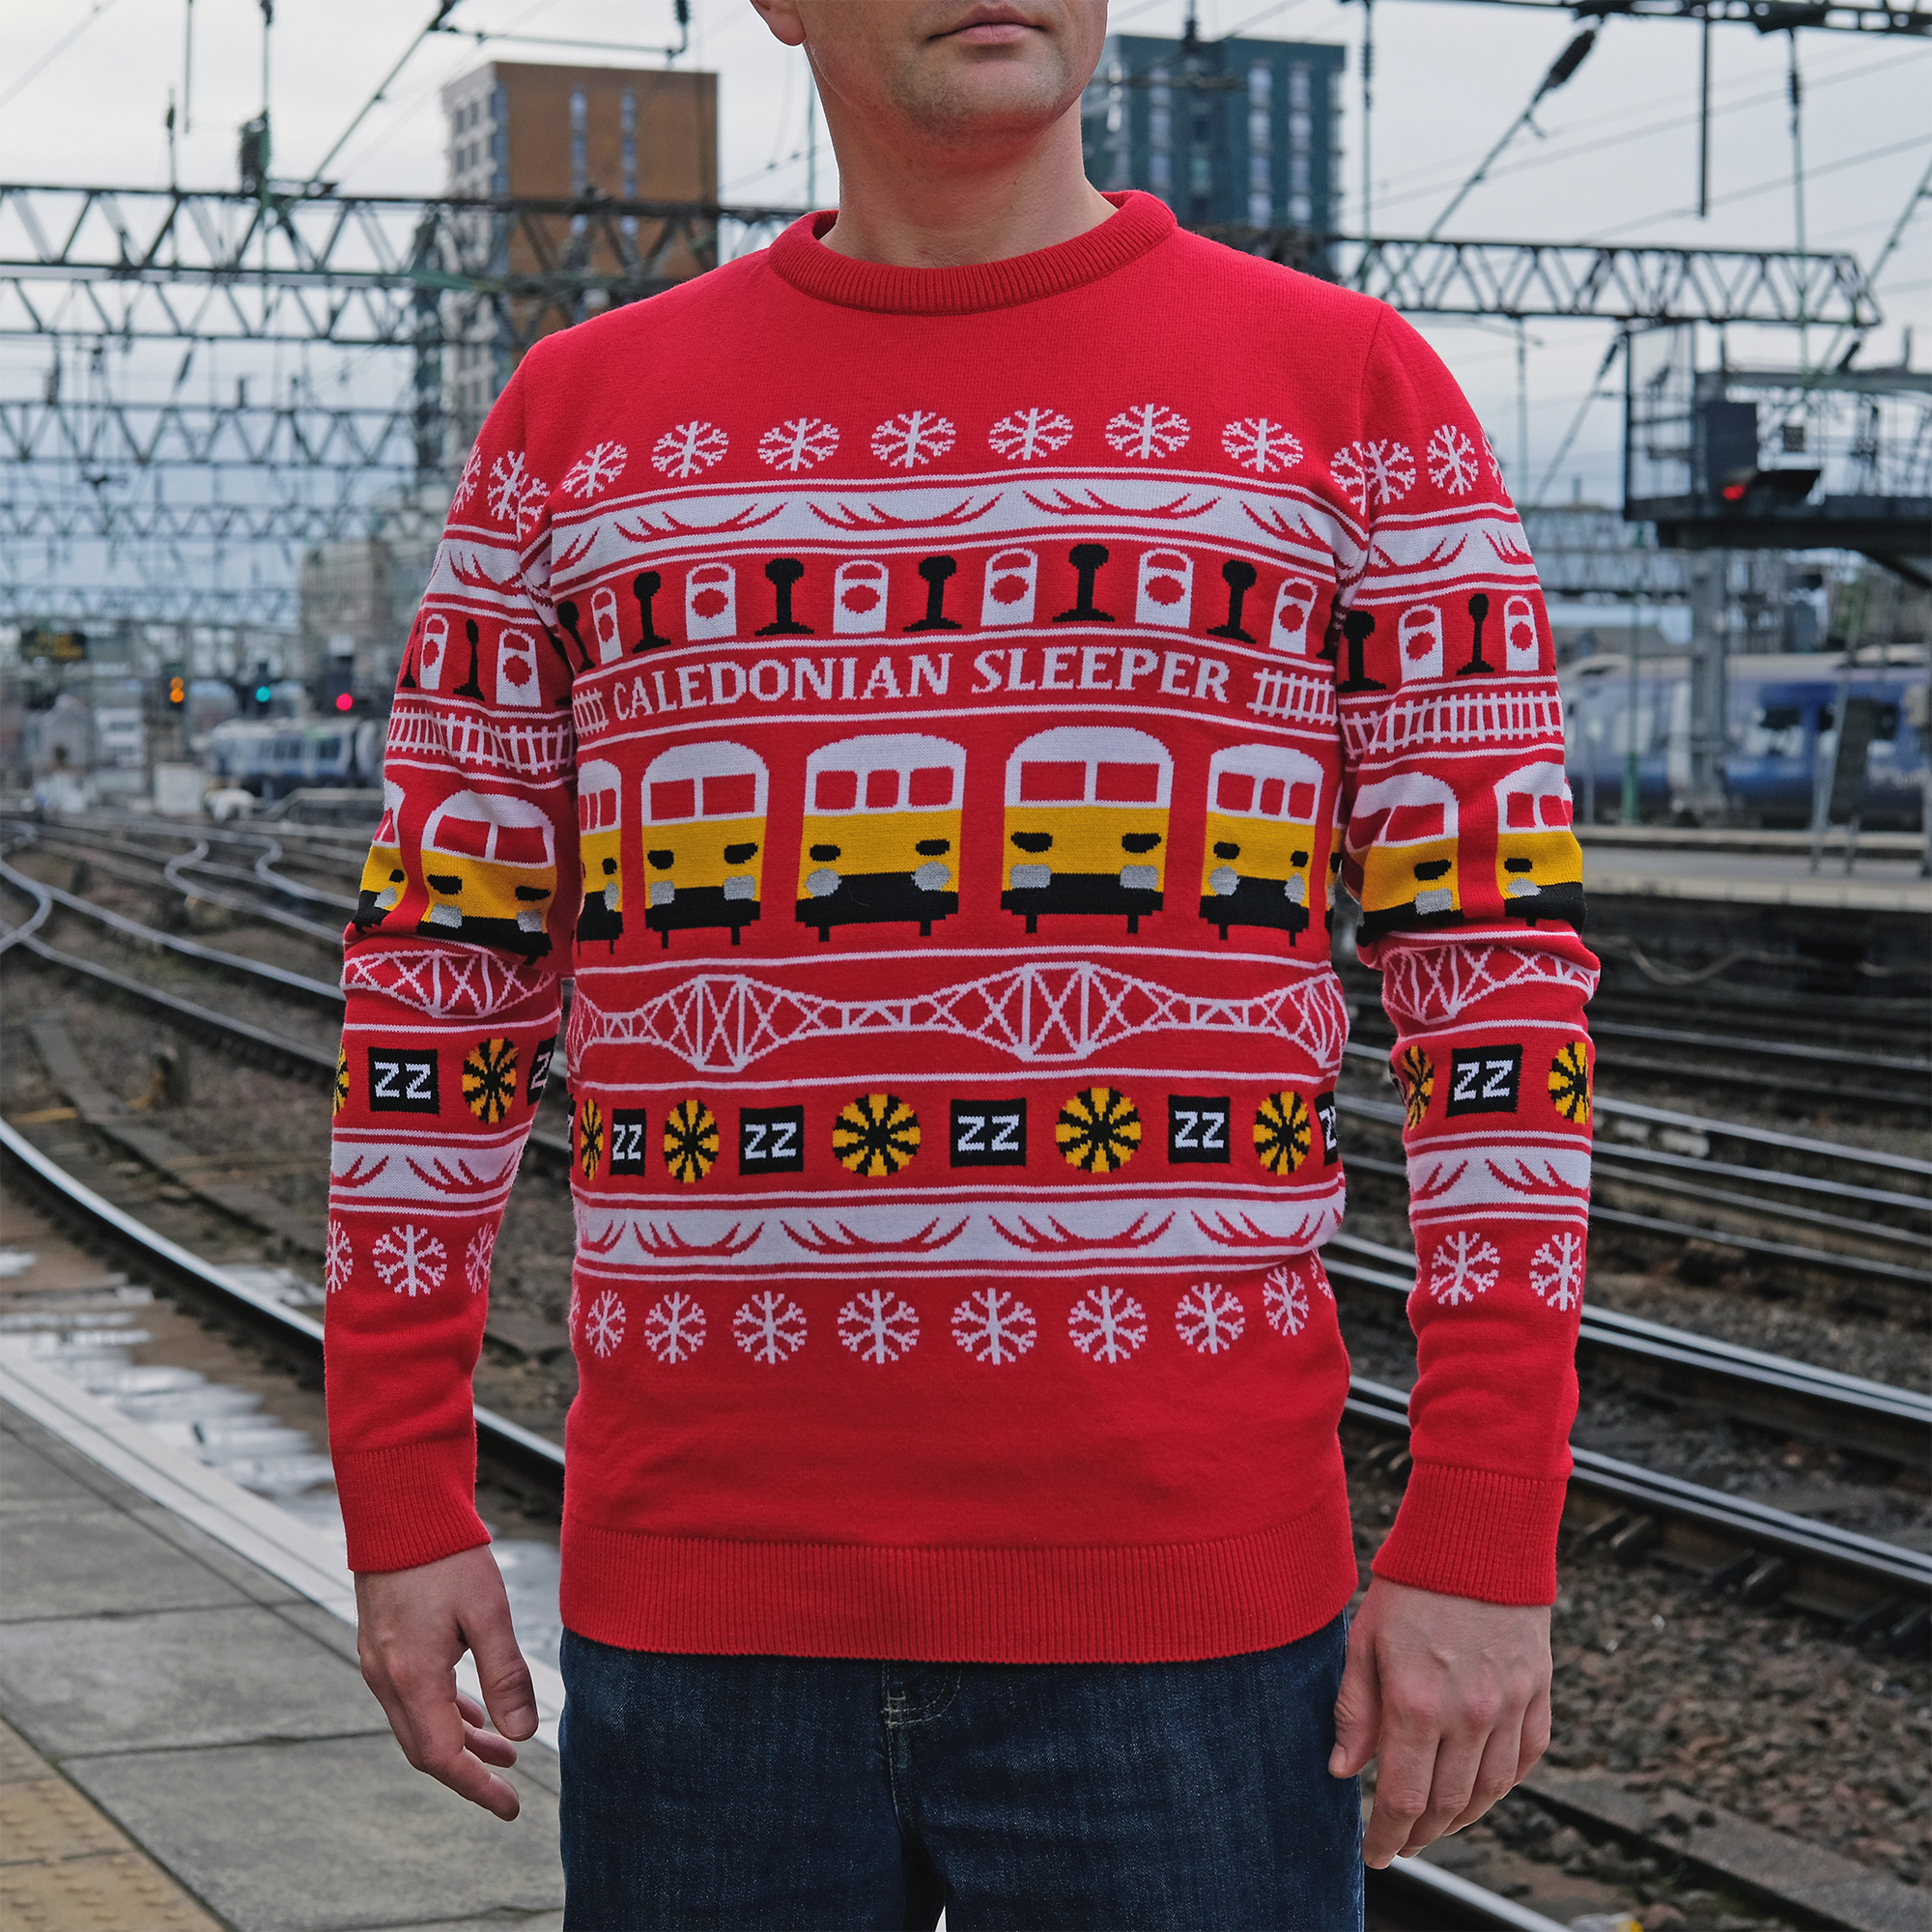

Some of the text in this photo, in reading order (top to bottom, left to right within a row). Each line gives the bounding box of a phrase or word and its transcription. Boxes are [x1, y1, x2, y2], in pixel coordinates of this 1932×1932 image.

[612, 645, 1232, 721] CALEDONIAN SLEEPER
[374, 1061, 432, 1100] ZZ
[1453, 1059, 1514, 1102] ZZ
[611, 1123, 642, 1161] ZZ
[744, 1122, 797, 1160] ZZ
[957, 1114, 1020, 1152] ZZ
[1175, 1110, 1225, 1150] ZZ
